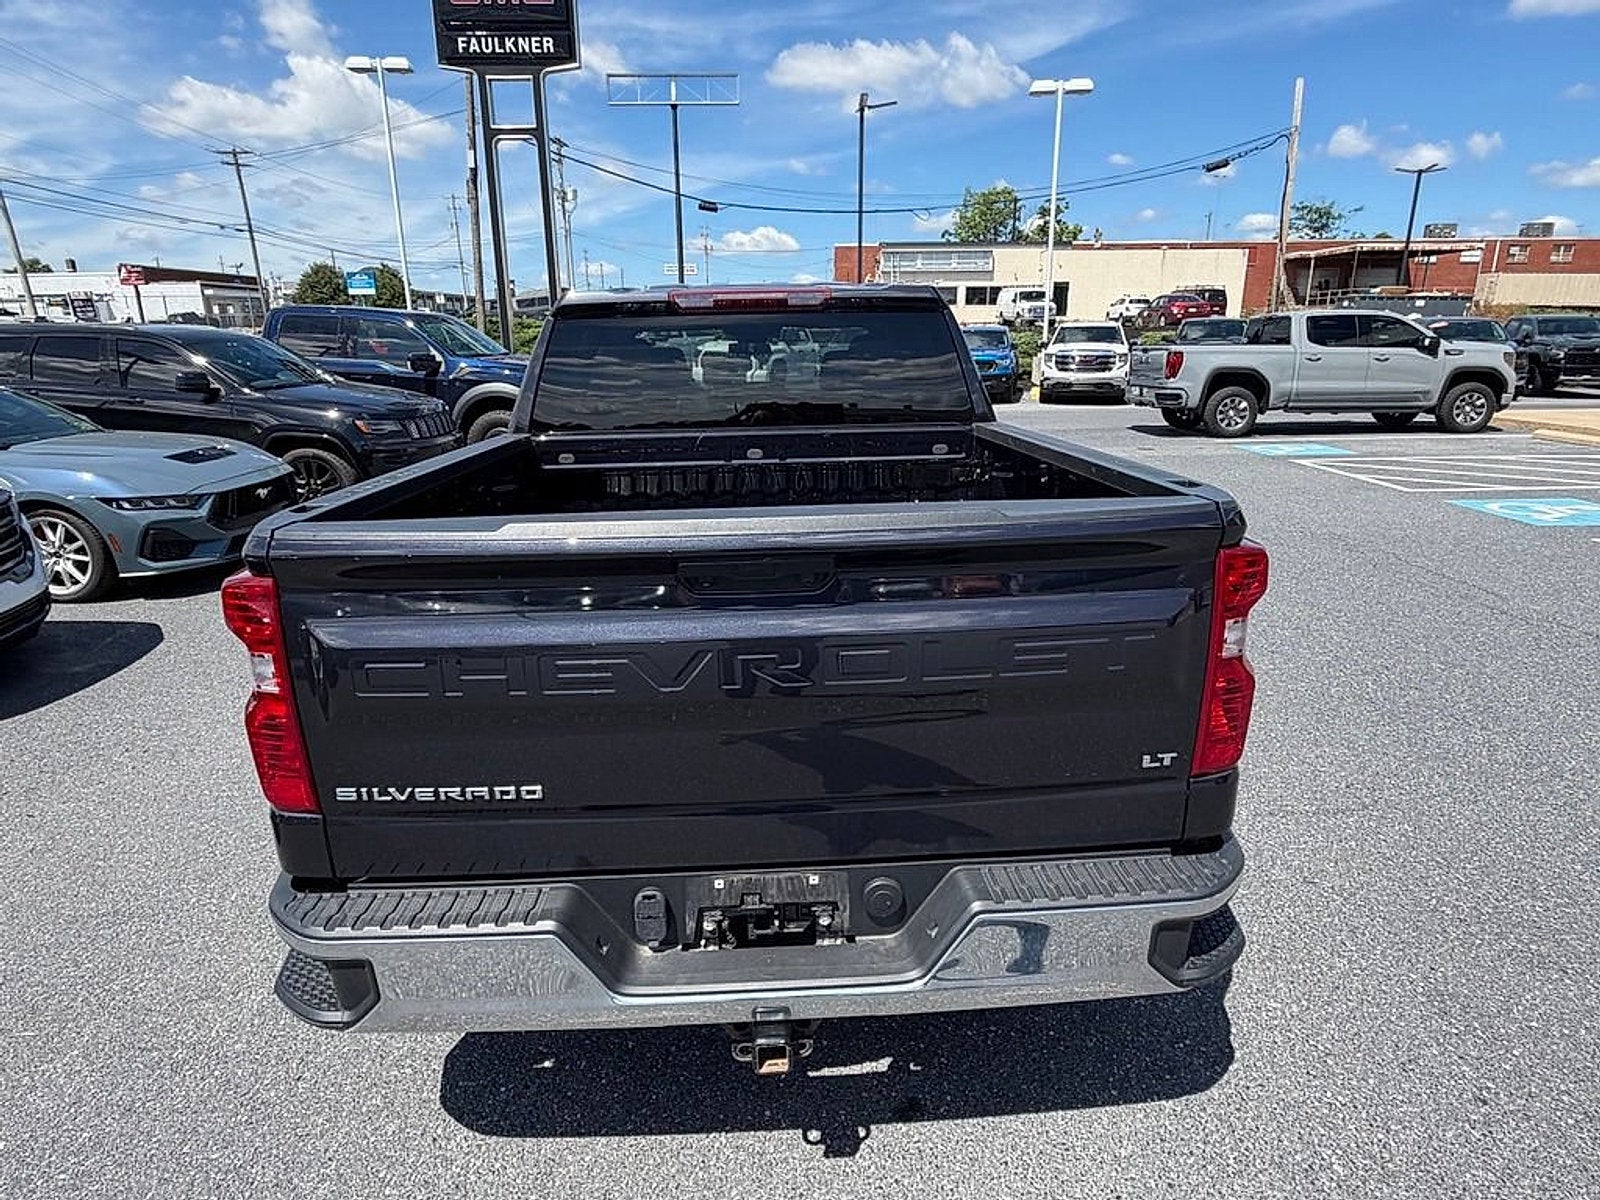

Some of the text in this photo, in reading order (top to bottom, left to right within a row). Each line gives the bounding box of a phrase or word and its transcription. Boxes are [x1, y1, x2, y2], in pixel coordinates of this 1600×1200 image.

[457, 36, 554, 53] FAULKNER
[350, 630, 1157, 699] CHEVROLET
[1142, 752, 1178, 769] LT
[335, 784, 543, 801] SILVERADO
